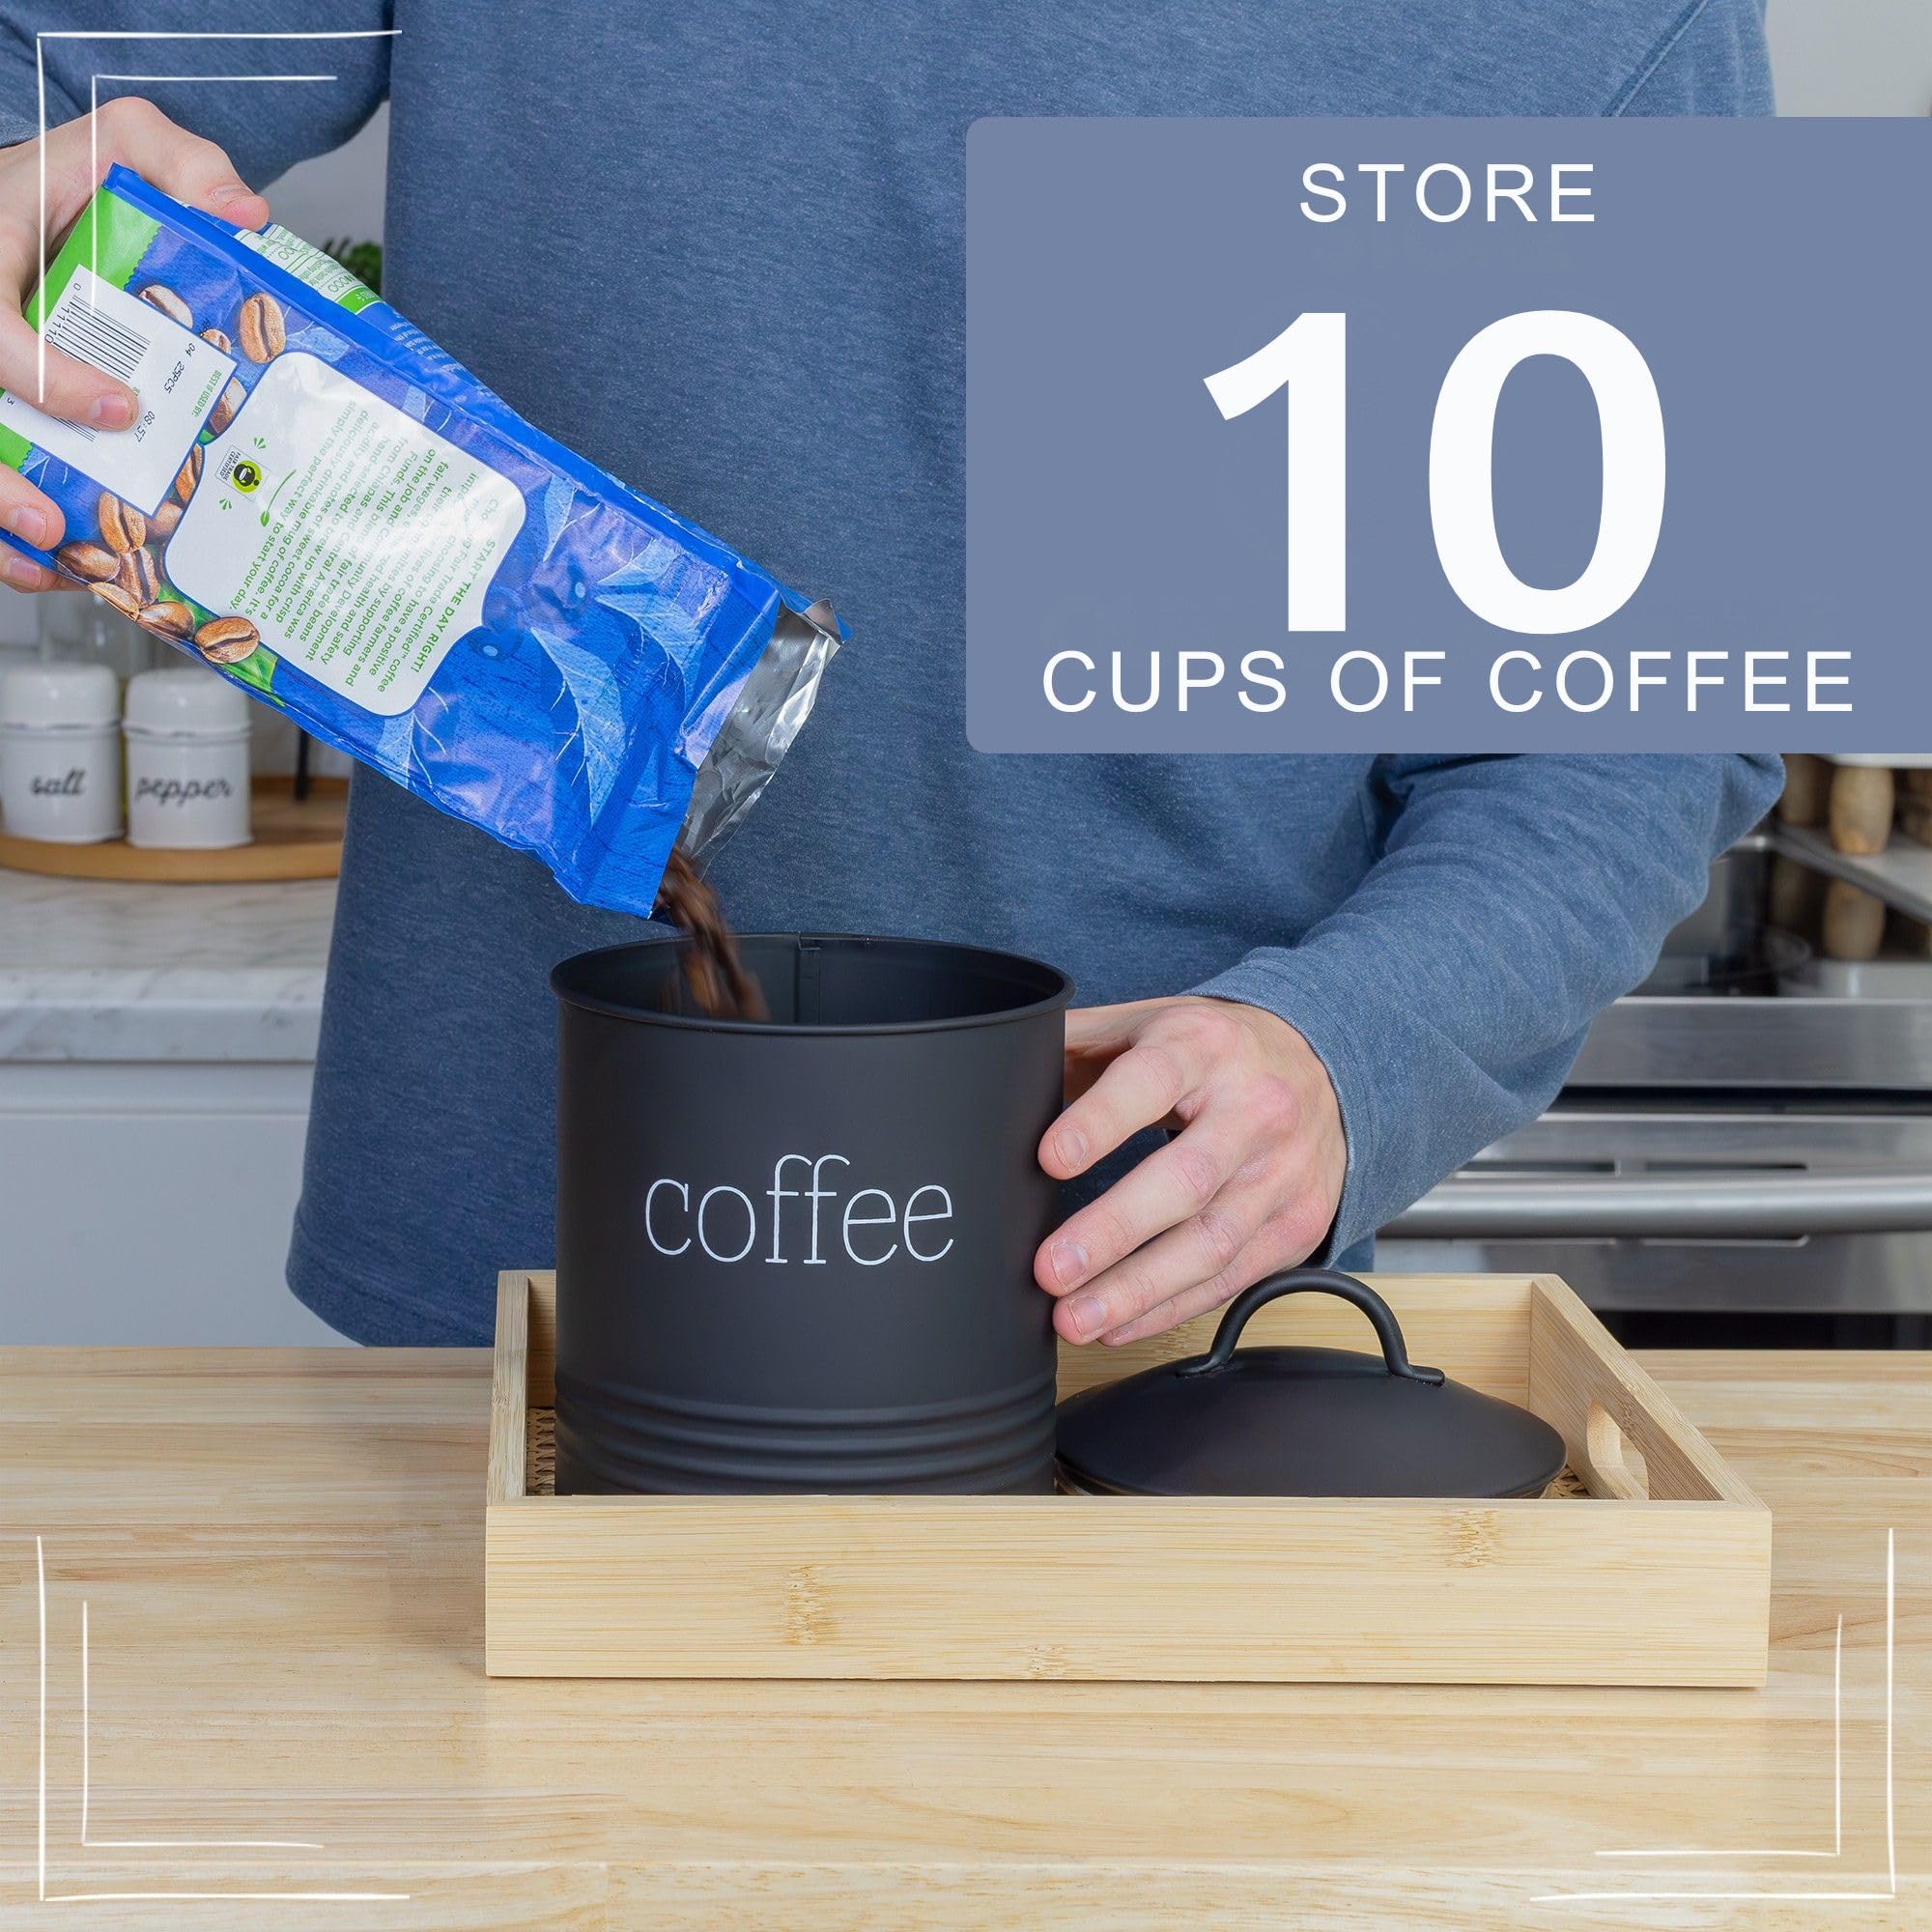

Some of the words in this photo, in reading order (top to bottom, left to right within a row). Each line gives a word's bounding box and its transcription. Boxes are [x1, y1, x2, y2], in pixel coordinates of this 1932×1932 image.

[183, 341, 197, 356] 04
[204, 384, 214, 393] IF
[208, 369, 222, 386] BEST
[190, 405, 202, 418] BY:
[195, 389, 211, 408] USED
[130, 409, 156, 442] 08:57
[327, 398, 358, 439] simply
[318, 436, 336, 458] the
[327, 408, 371, 470] deliciously
[385, 435, 409, 466] from
[389, 449, 418, 490] Funds.
[422, 447, 437, 465] on
[221, 464, 235, 481] TRADE
[291, 455, 324, 499] perfect
[337, 459, 357, 483] and
[337, 434, 391, 514] hand-selected
[410, 464, 428, 485] the
[431, 460, 449, 482] fair
[297, 467, 335, 522] drinkable
[319, 481, 344, 515] notes
[357, 462, 392, 510] Chiapas
[374, 487, 396, 514] This
[397, 482, 417, 505] job
[406, 479, 436, 521] wages,
[430, 485, 453, 514] their
[276, 496, 298, 523] way
[310, 513, 326, 529] of
[328, 511, 344, 527] to
[346, 507, 366, 532] and
[384, 503, 405, 527] and
[270, 521, 285, 536] to
[280, 519, 303, 547] mug
[312, 525, 335, 555] brew
[255, 533, 278, 563] start
[274, 545, 289, 561] of
[291, 527, 317, 561] sweet
[321, 529, 352, 573] Central
[466, 537, 497, 580] START
[301, 554, 318, 572] up
[334, 557, 353, 580] fair
[420, 532, 459, 586] choosing
[446, 549, 468, 574] Fair
[239, 560, 262, 588] your
[253, 558, 282, 598] coffee.
[271, 559, 298, 594] cocoa
[288, 571, 310, 597] with
[401, 572, 417, 589] of
[226, 586, 248, 613] day.
[263, 593, 280, 612] for
[294, 570, 327, 617] America
[316, 578, 341, 610] trade
[352, 573, 380, 610] health
[376, 581, 392, 598] by
[412, 583, 428, 600] to
[428, 572, 454, 606] Trade
[449, 579, 471, 607] THE
[272, 595, 296, 624] crisp
[381, 585, 409, 624] coffee
[396, 598, 419, 627] have
[434, 605, 455, 633] DAY
[282, 616, 300, 639] was
[297, 608, 323, 642] beans
[302, 588, 353, 663] Development
[339, 608, 359, 632] and
[340, 596, 384, 658] supporting
[318, 629, 346, 667] safety
[356, 621, 387, 665] farmers
[365, 632, 399, 678] positive
[410, 632, 440, 673] RIGHT!
[343, 663, 363, 687] and
[375, 657, 403, 695] coffee
[135, 775, 234, 809] pepper
[644, 1153, 954, 1266] coffee
